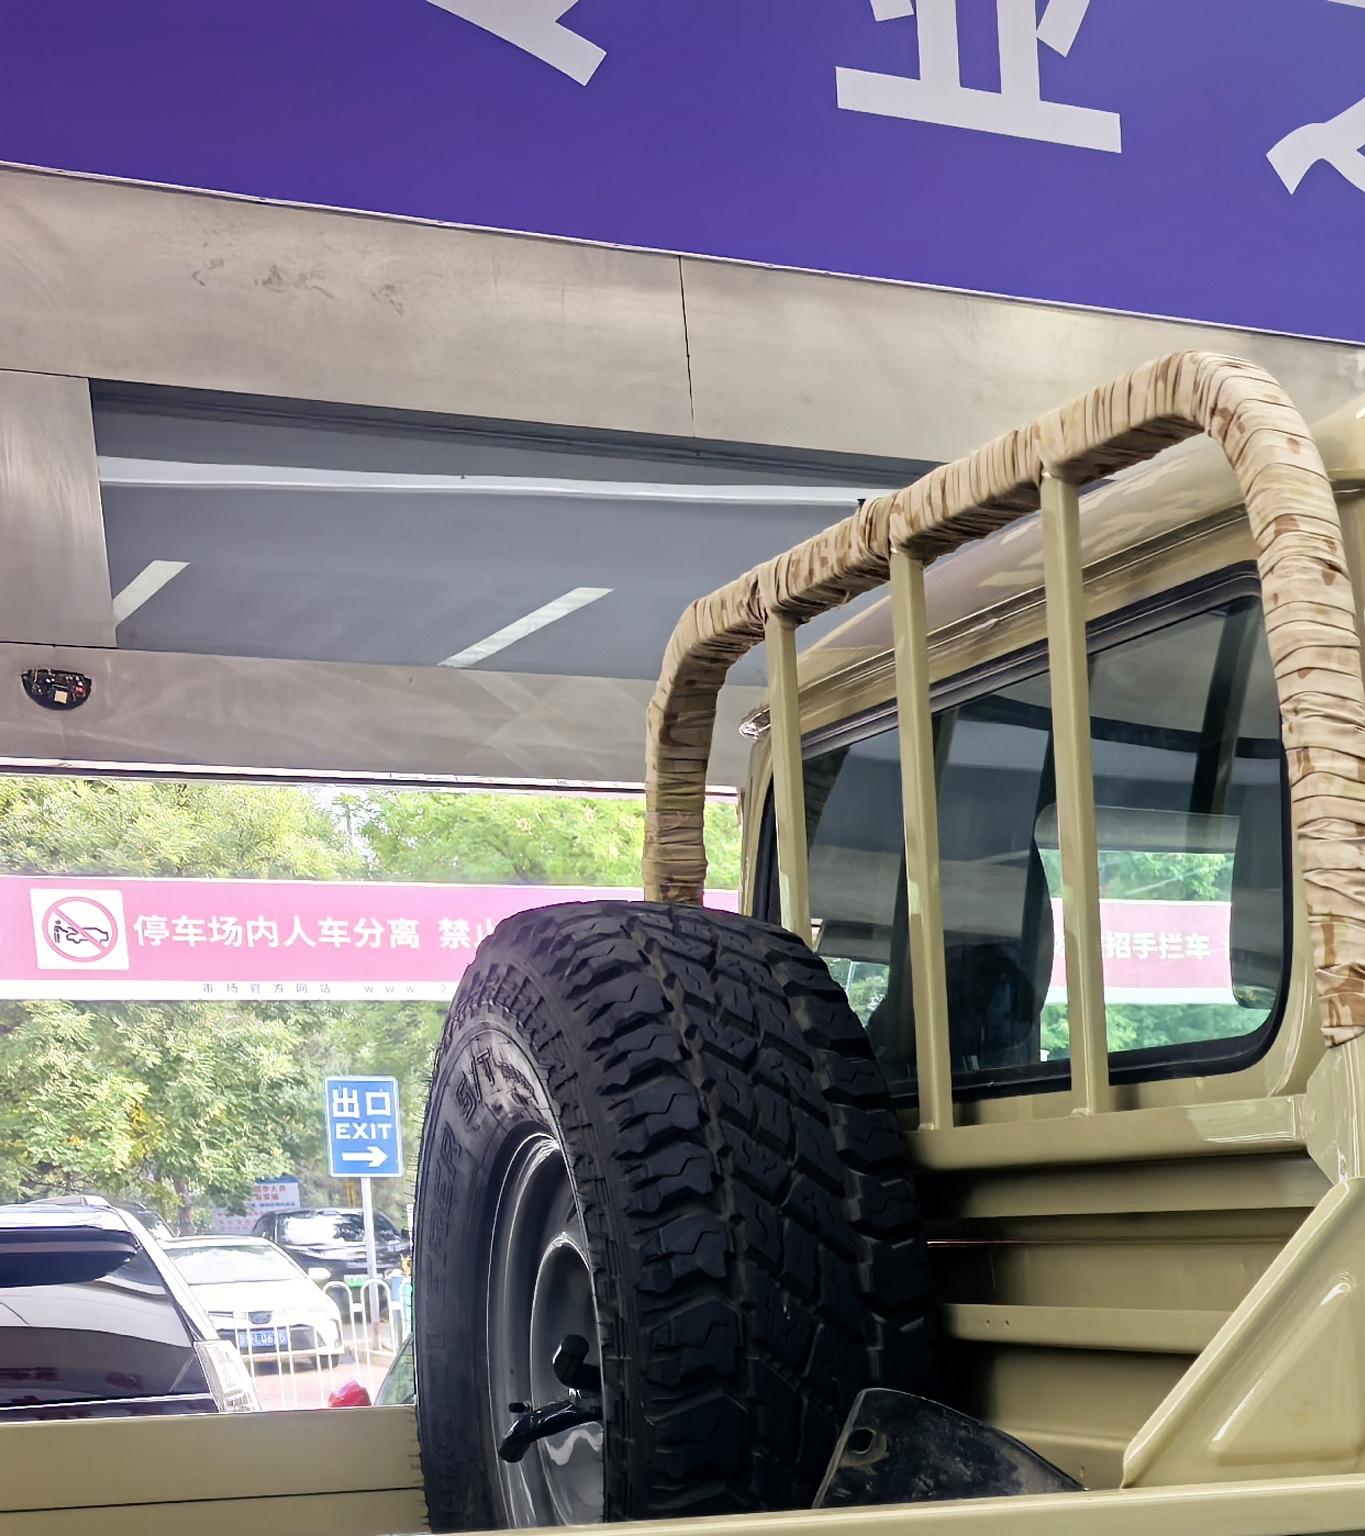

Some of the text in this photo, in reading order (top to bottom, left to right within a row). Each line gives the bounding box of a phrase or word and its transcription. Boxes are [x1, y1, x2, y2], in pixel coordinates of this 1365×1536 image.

[133, 914, 420, 949] 停车场内人车分离
[332, 1087, 392, 1119] 出口
[335, 1122, 392, 1140] EXIT
